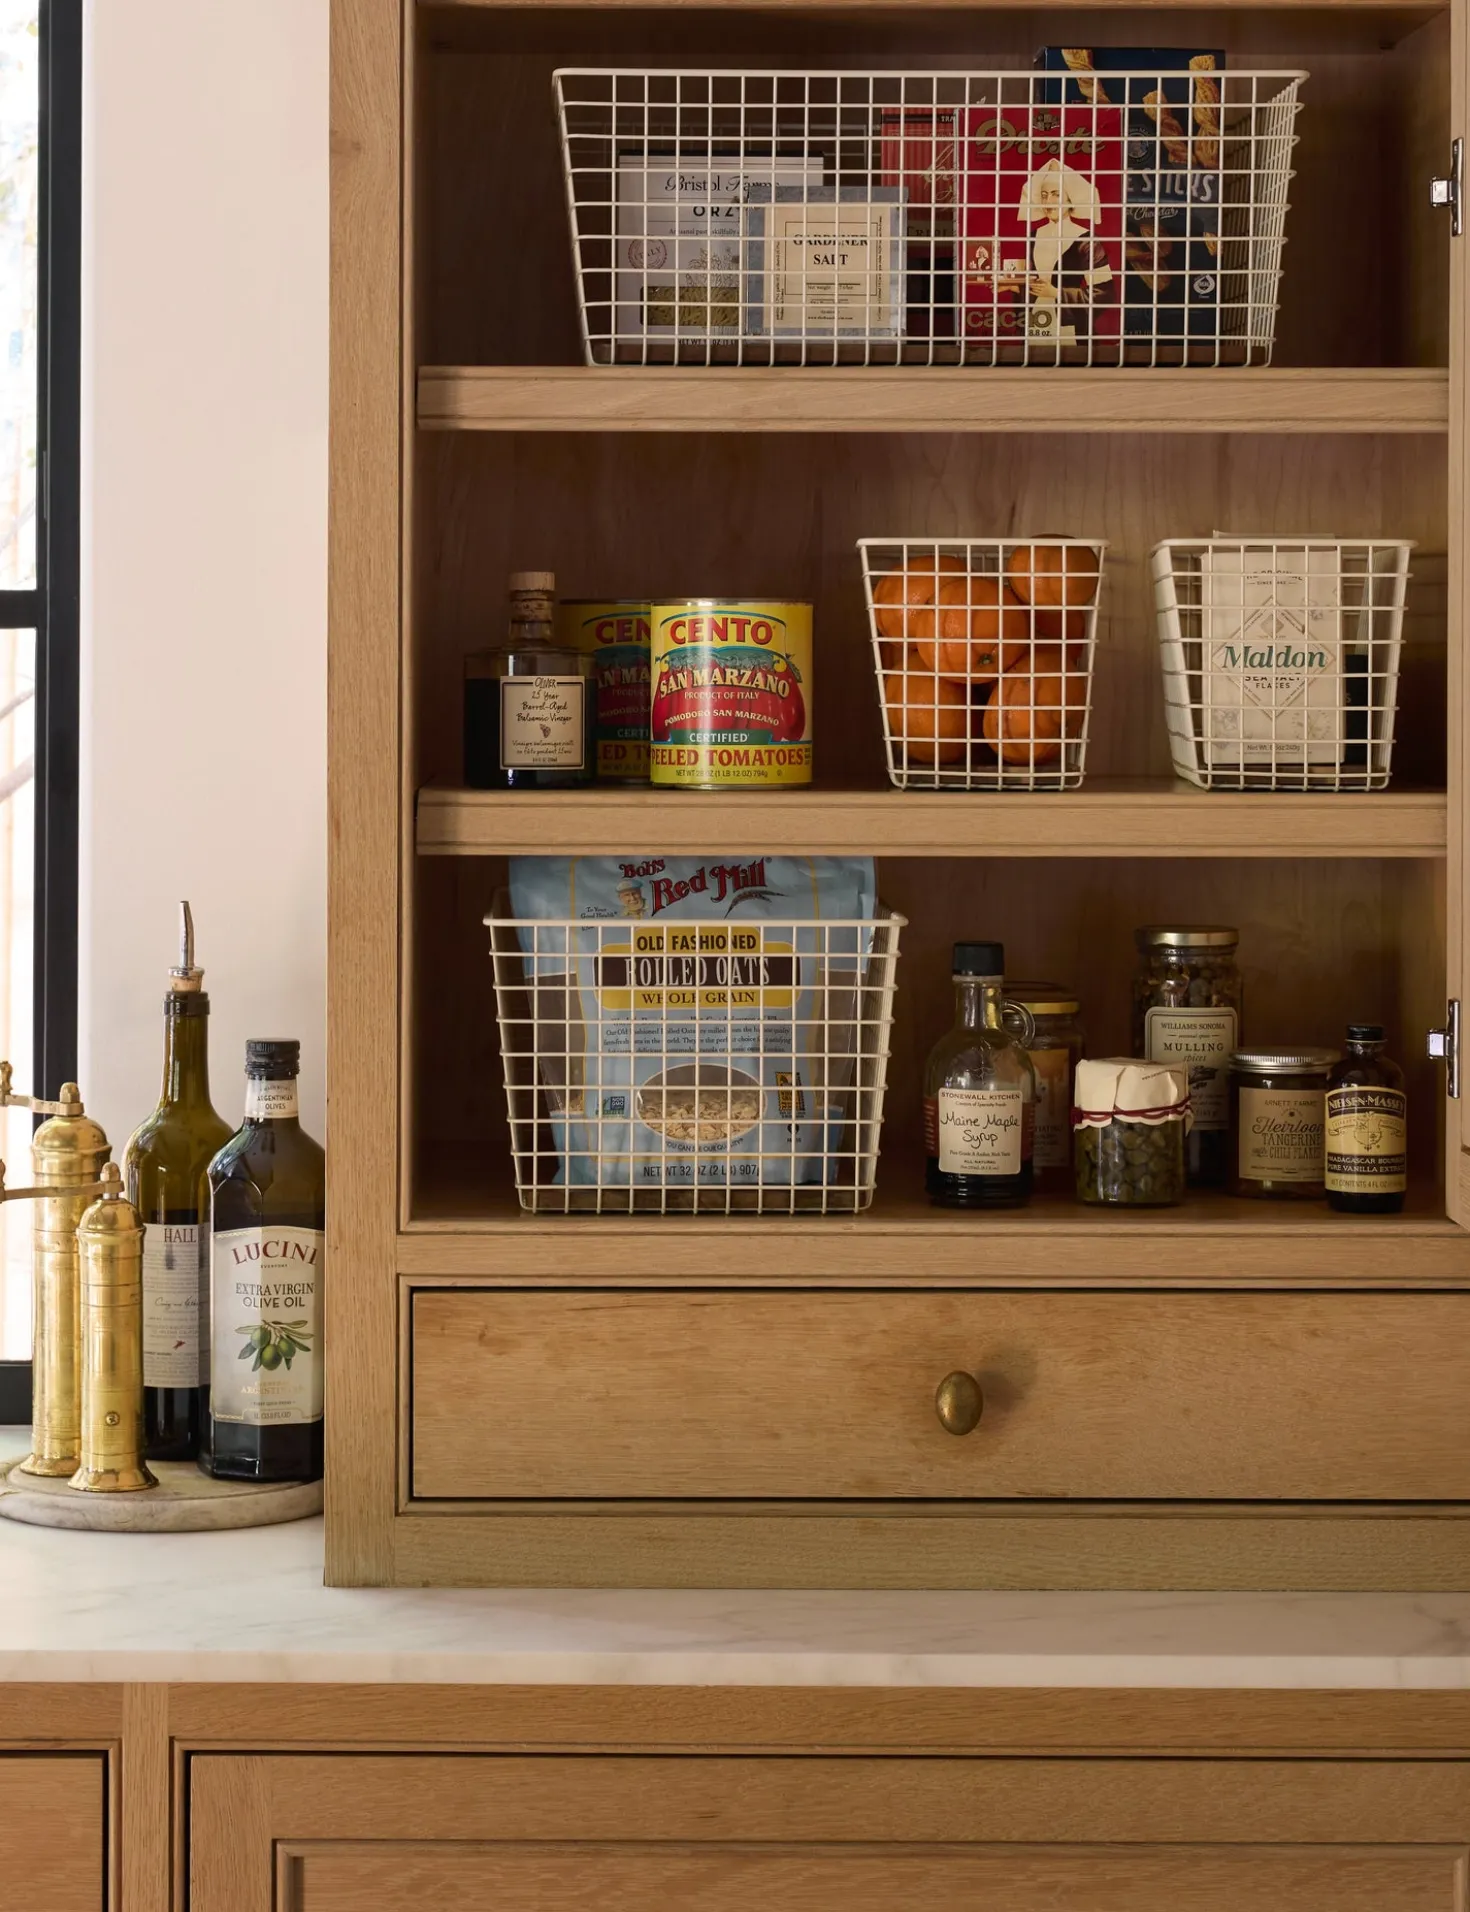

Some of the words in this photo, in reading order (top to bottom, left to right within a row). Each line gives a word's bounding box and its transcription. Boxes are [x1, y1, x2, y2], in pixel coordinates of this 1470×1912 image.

[974, 119, 1105, 155] Droste
[1142, 168, 1214, 202] SICKS
[966, 310, 1052, 328] cacao
[595, 617, 651, 645] CEN
[670, 617, 773, 645] CENTO
[1222, 645, 1326, 668] Maldon
[660, 671, 687, 698] SAN
[692, 667, 790, 699] MARZANO
[684, 691, 721, 700] PRODUCT
[724, 691, 735, 699] OF
[737, 691, 760, 699] ITALY
[664, 709, 711, 726] POMODORO
[713, 709, 732, 717] SAN
[735, 710, 780, 726] MARZANO
[689, 732, 748, 743] CERTIFIED
[651, 748, 699, 766] PEELED
[707, 748, 804, 766] TOMATOES
[619, 857, 666, 878] Bob's
[650, 867, 710, 917] Red
[710, 857, 767, 903] Mill
[637, 935, 665, 951] OLD
[672, 934, 757, 950] FASHIONED
[625, 957, 707, 986] ROLLED
[716, 956, 770, 985] OATS
[642, 991, 700, 1004] WHOLE
[705, 990, 755, 1003] GRAIN
[1161, 1022, 1197, 1030] WILLIAMS
[1198, 1022, 1226, 1030] SONOMA
[1163, 1043, 1224, 1052] MULLING
[941, 1091, 986, 1100] STONEWALL
[989, 1093, 1020, 1101] KITCHEN
[940, 1111, 980, 1127] Maine
[983, 1113, 1020, 1132] Maple
[962, 1129, 998, 1149] Syrup
[643, 1166, 660, 1177] NET
[680, 1165, 691, 1176] 32
[709, 1165, 719, 1177] (2
[1342, 1164, 1378, 1173] VANILLA
[164, 1228, 197, 1243] HALL
[231, 1240, 318, 1265] LUCINI
[236, 1282, 272, 1296] EXTRA
[273, 1282, 314, 1296] VIRGIN
[243, 1297, 280, 1308] OLIVE
[284, 1296, 306, 1307] OIL
